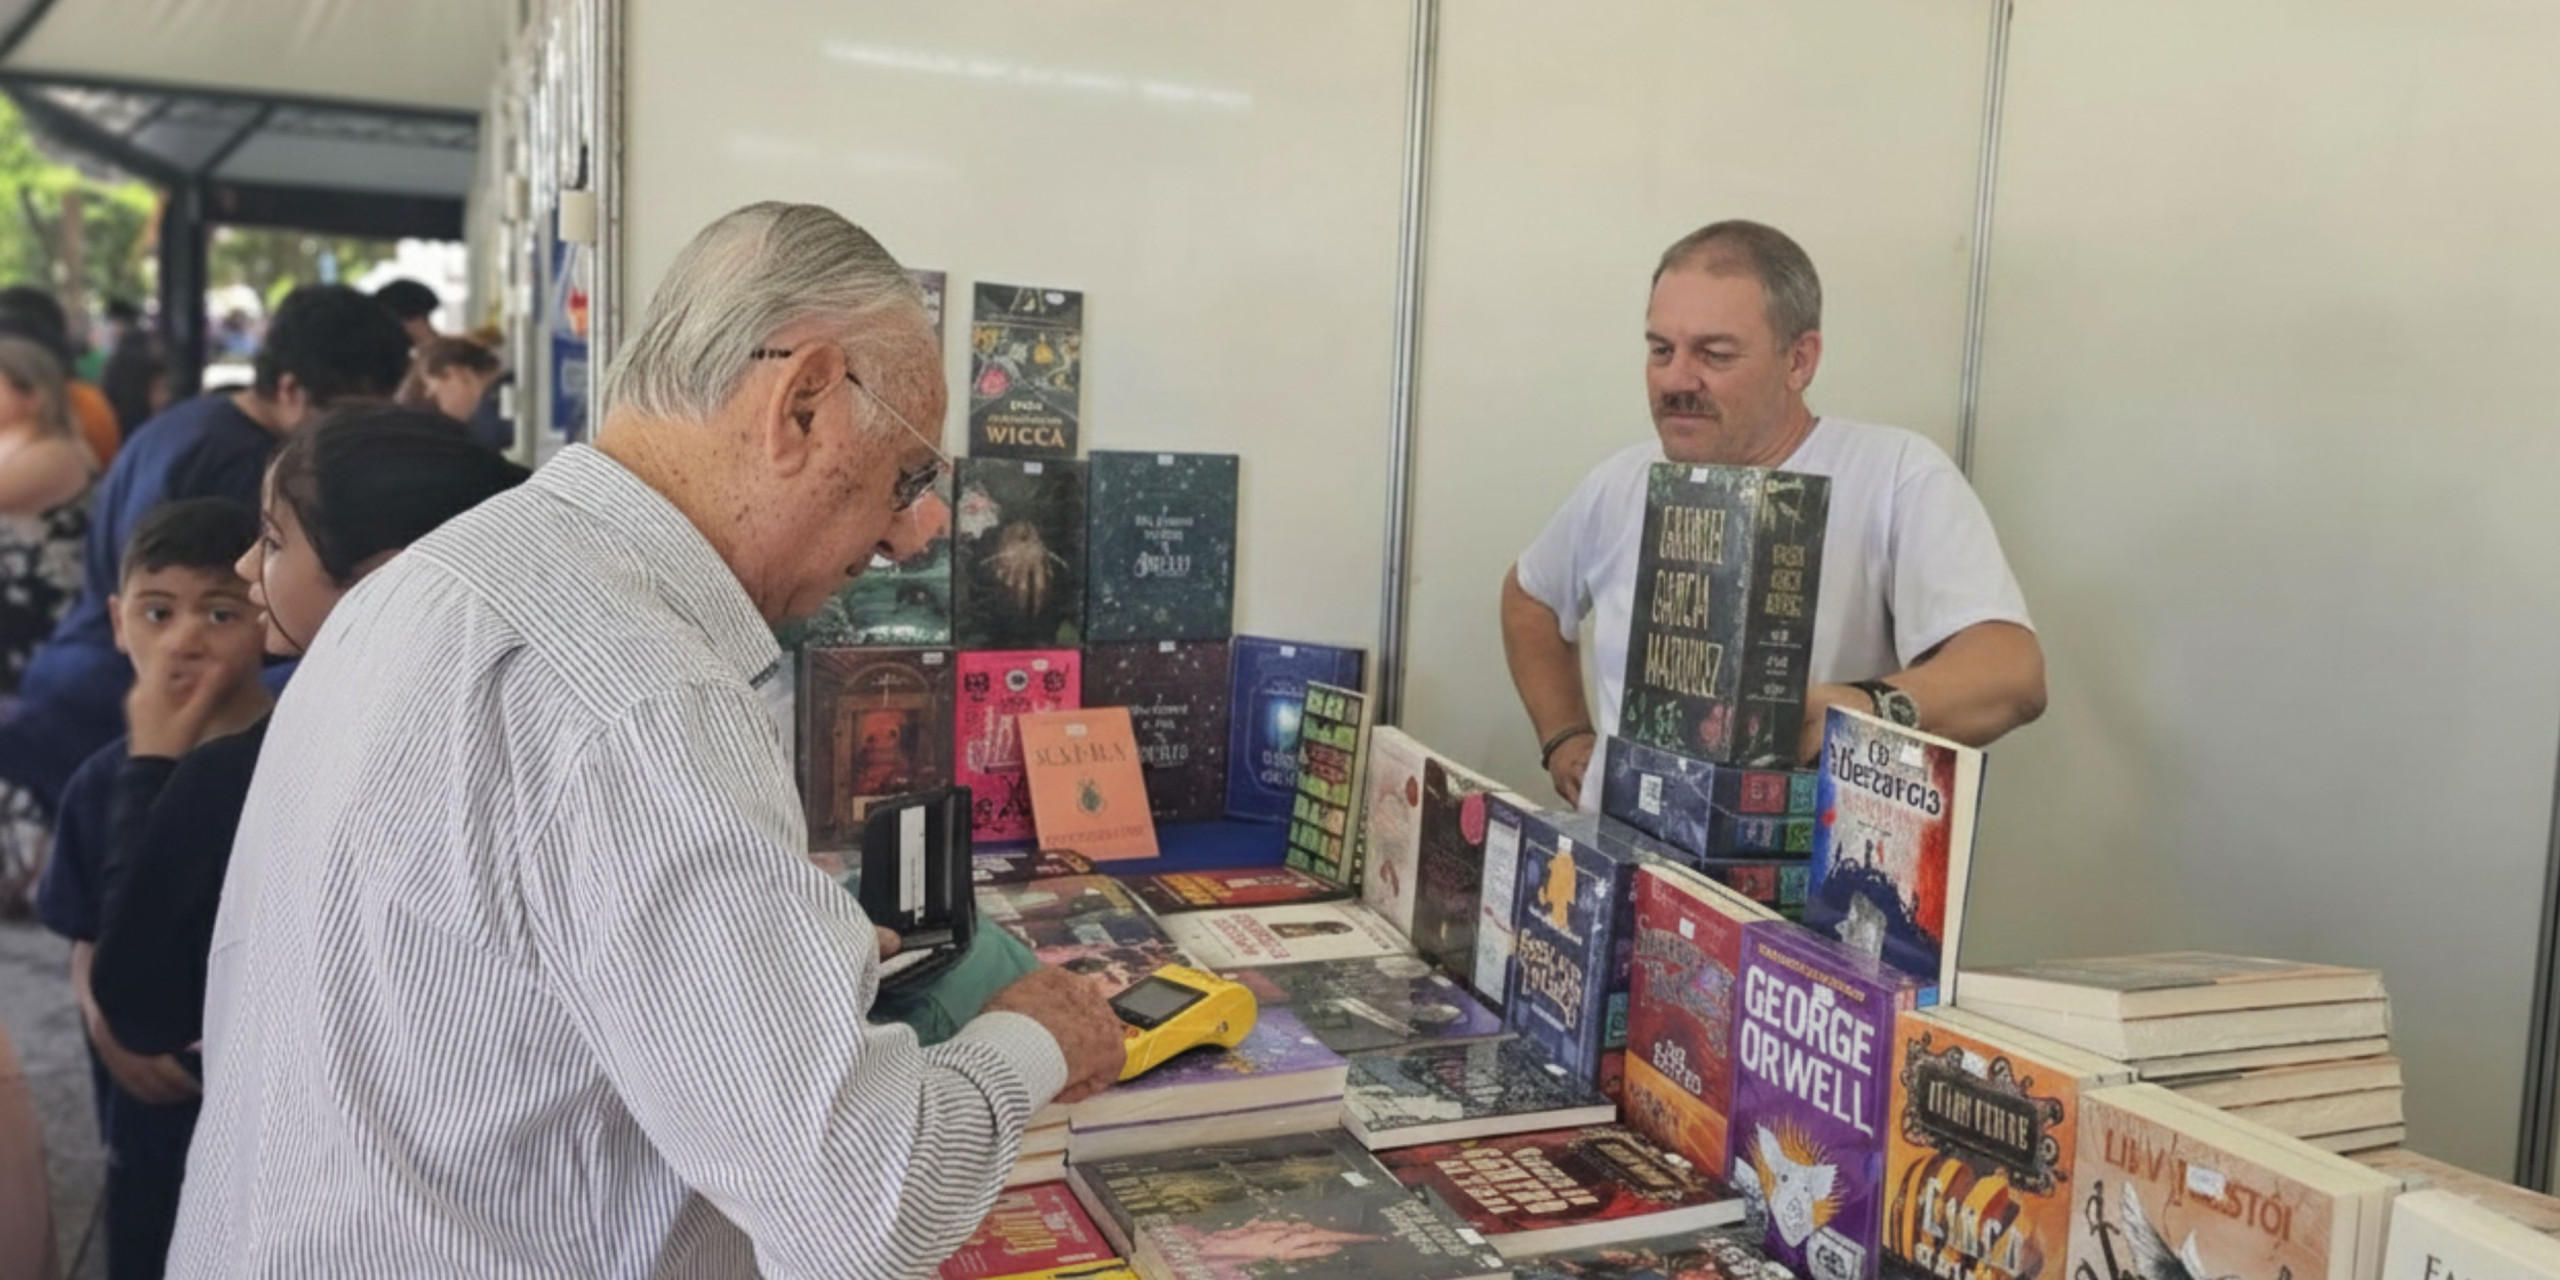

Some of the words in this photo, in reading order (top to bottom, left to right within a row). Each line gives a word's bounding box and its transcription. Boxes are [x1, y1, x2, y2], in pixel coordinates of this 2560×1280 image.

[986, 426, 1066, 448] WICCA
[1745, 964, 1875, 1077] GEORGE
[1741, 1018, 1874, 1139] ORWELL
